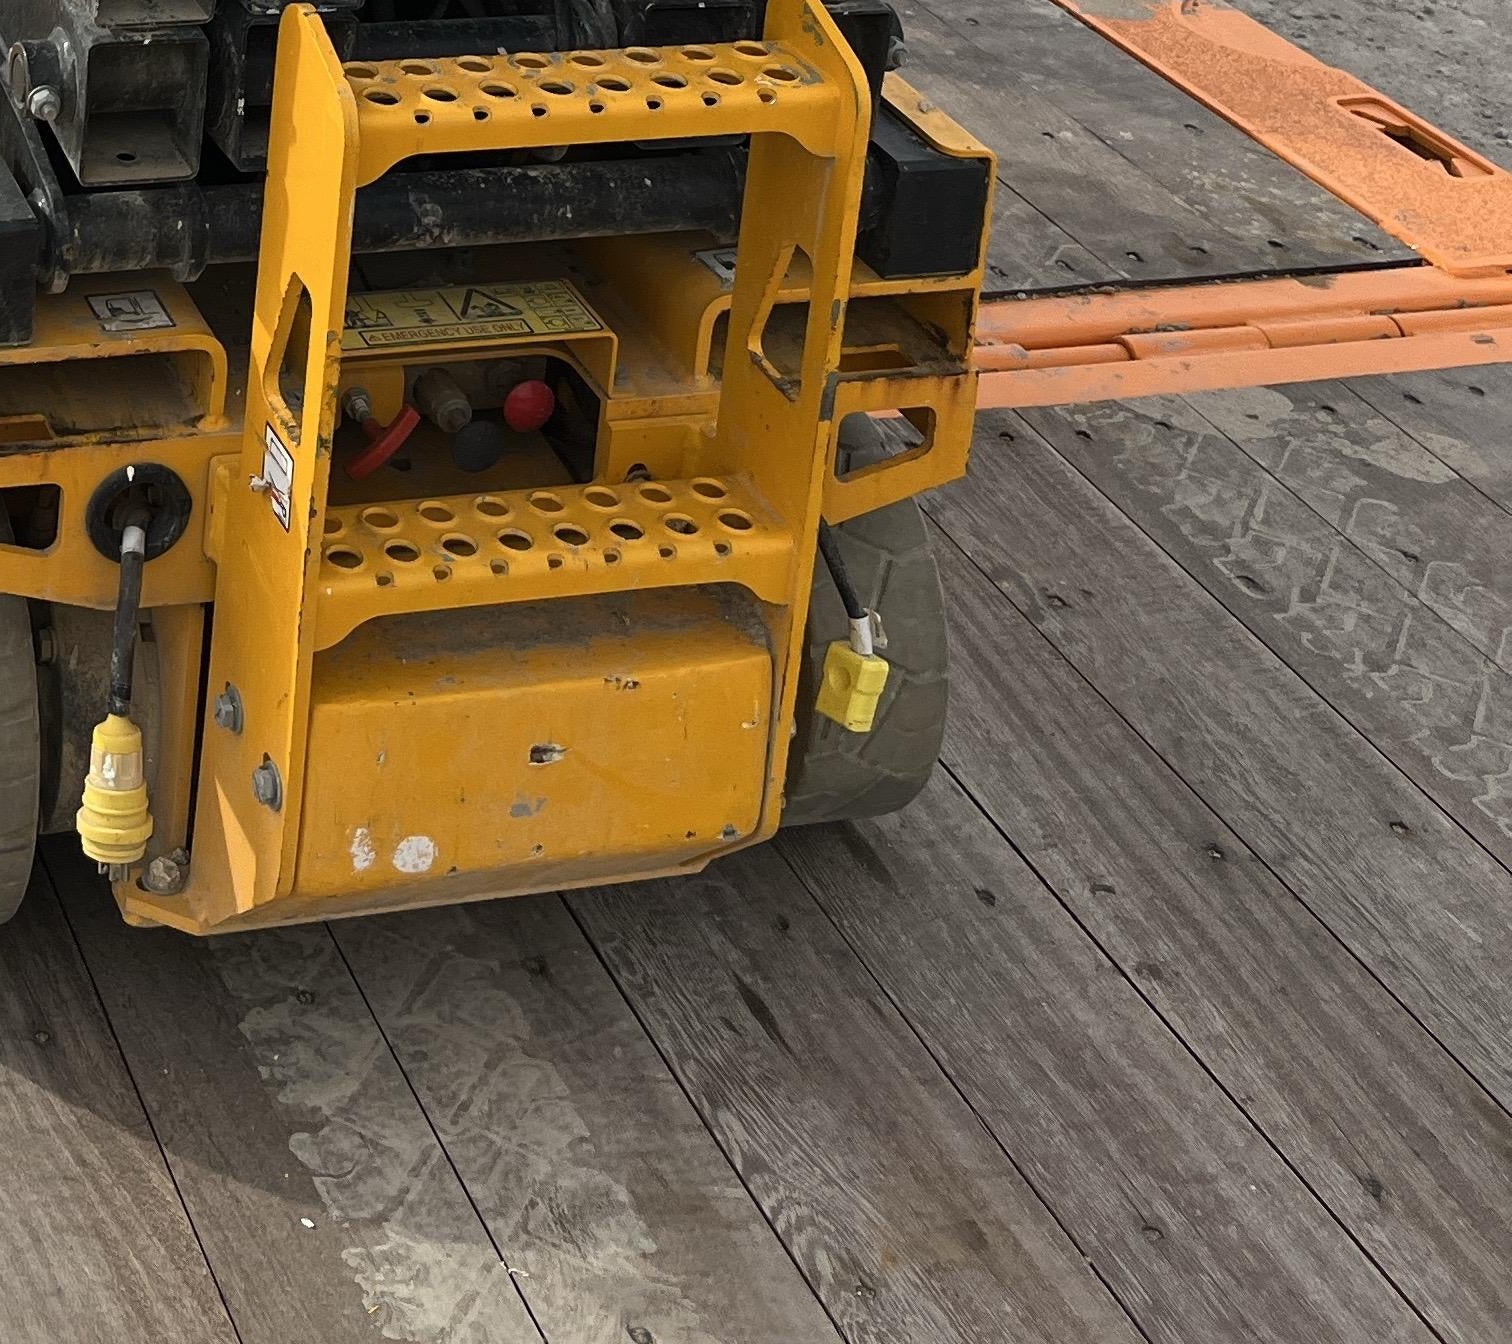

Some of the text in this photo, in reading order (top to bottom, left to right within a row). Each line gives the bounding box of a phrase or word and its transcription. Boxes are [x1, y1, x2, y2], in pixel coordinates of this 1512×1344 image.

[381, 321, 526, 343] EMERGENCY USE ONLY
